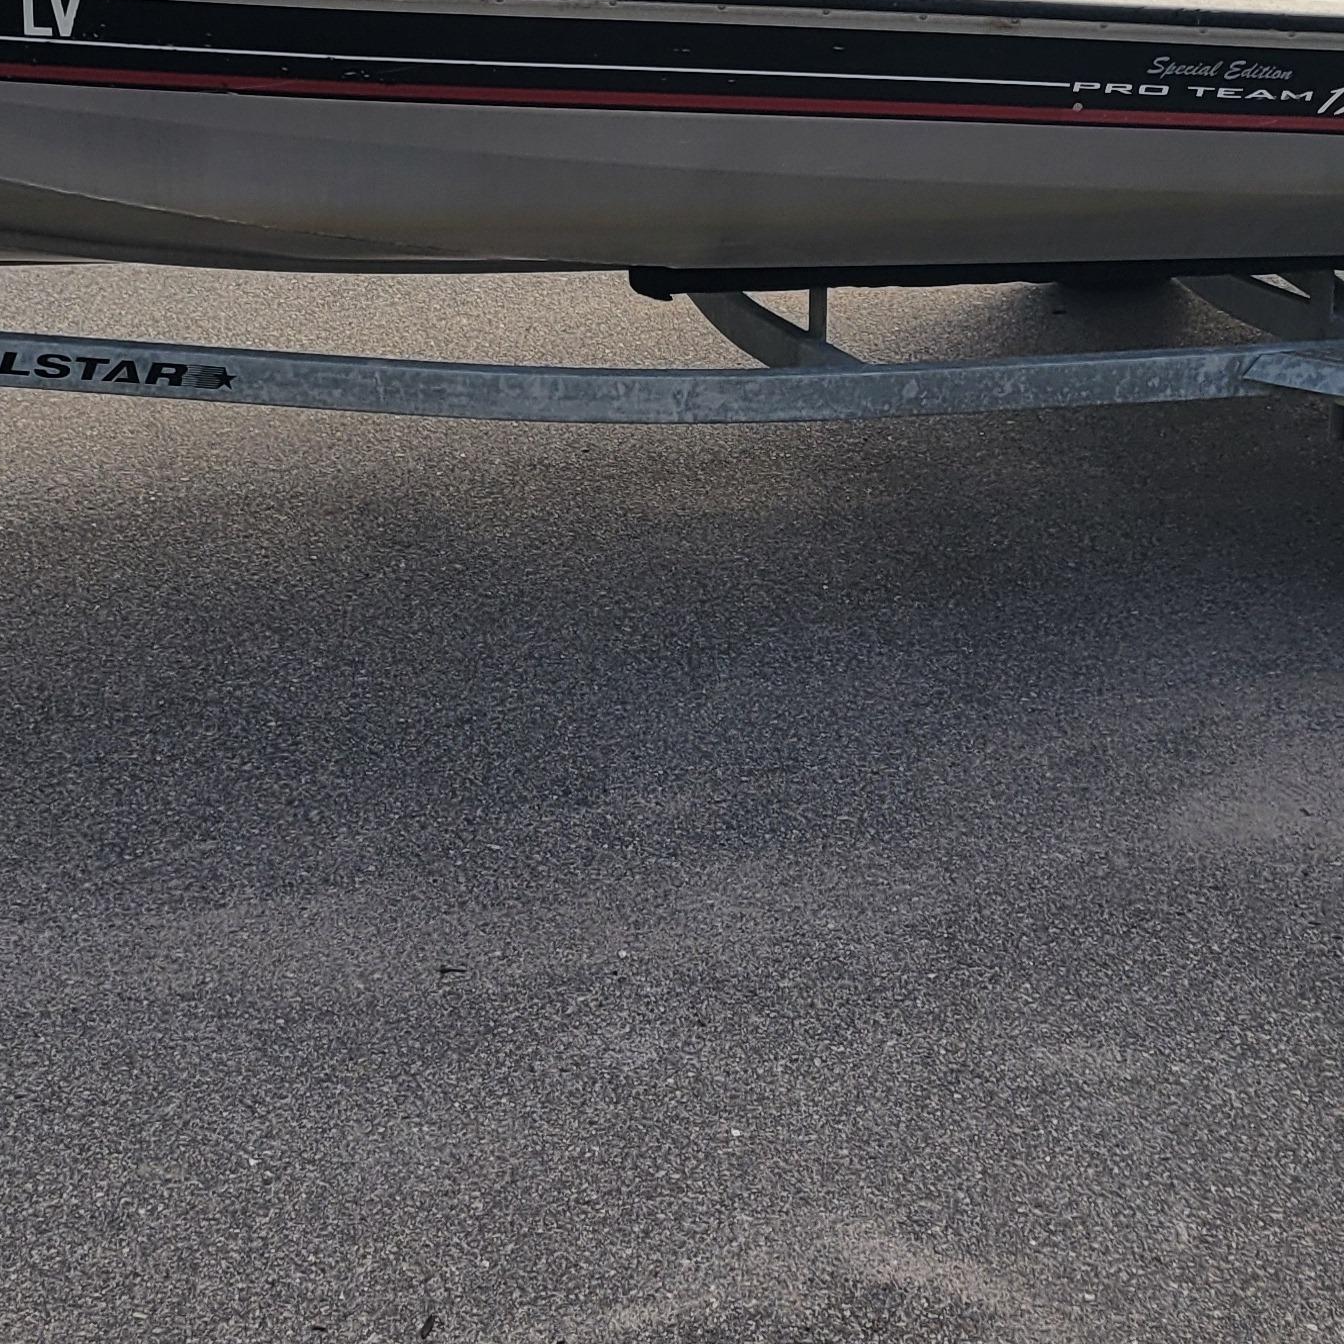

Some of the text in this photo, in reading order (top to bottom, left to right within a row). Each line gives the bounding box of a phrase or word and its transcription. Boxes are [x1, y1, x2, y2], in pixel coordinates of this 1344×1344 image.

[1147, 56, 1294, 81] Special Edition
[1072, 82, 1170, 98] PRO
[1187, 85, 1314, 103] TEAM
